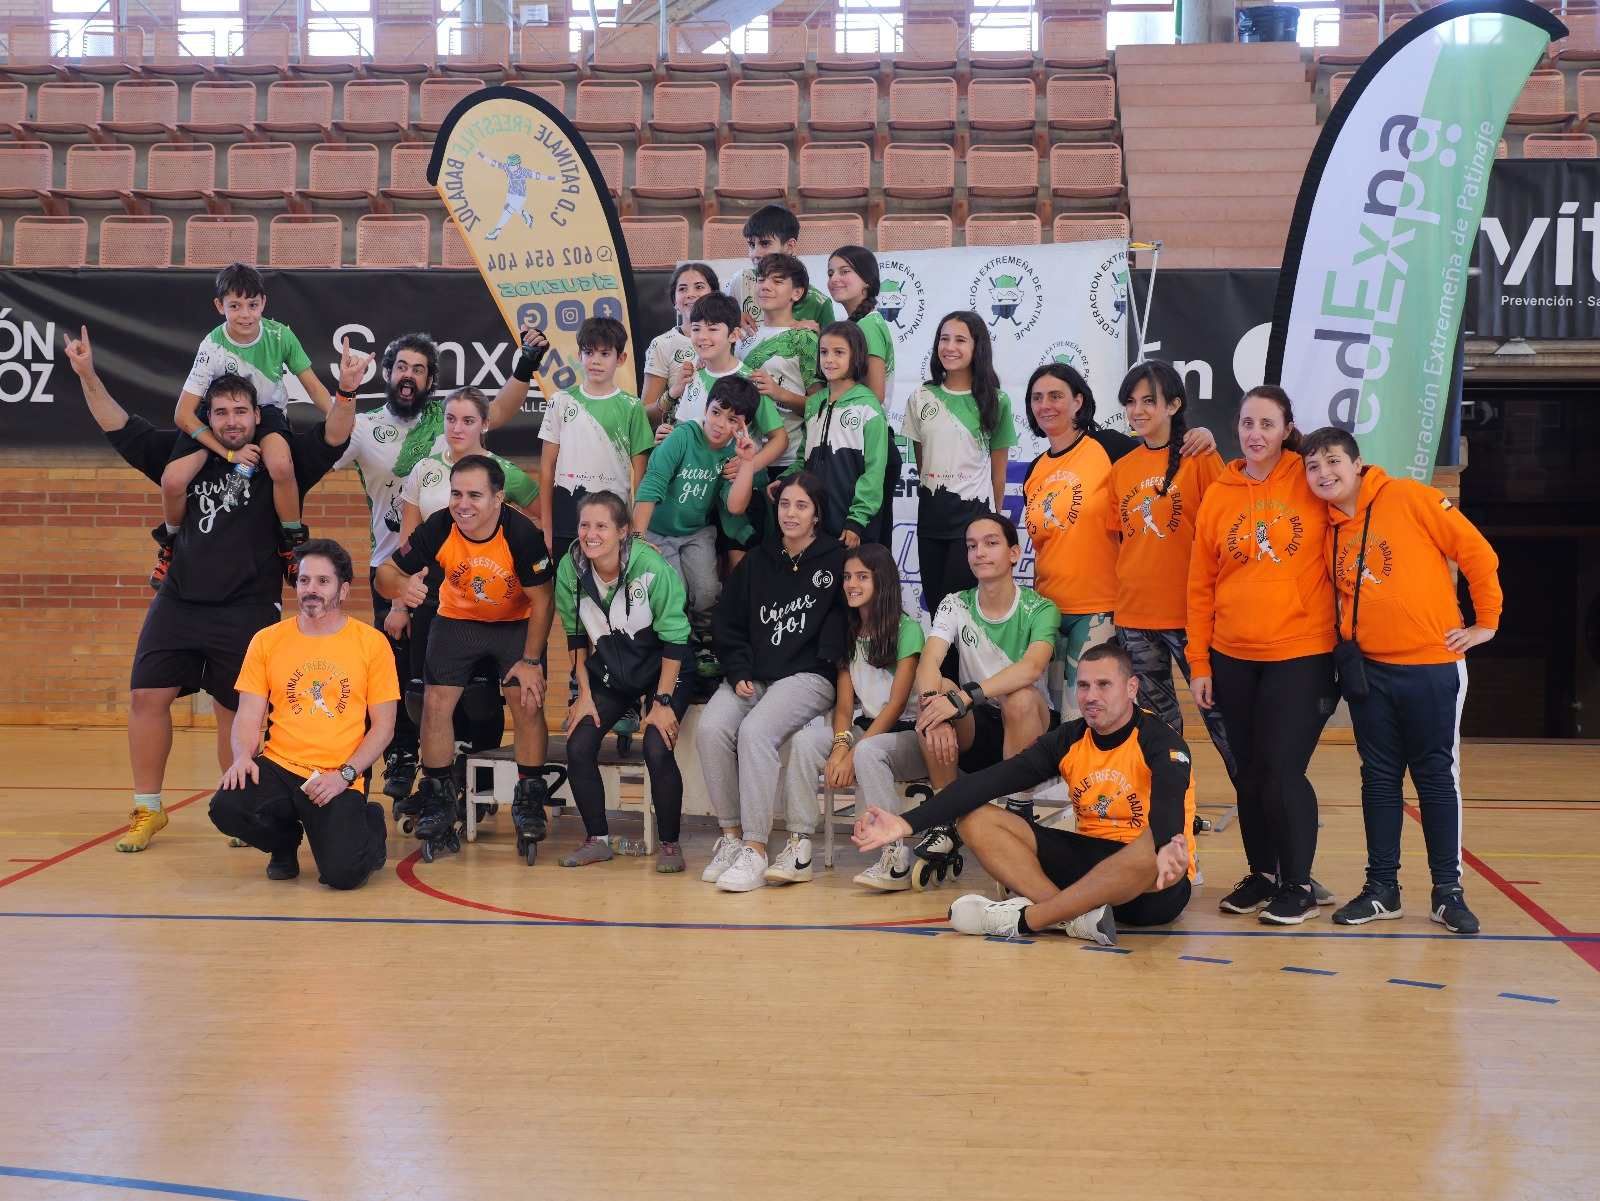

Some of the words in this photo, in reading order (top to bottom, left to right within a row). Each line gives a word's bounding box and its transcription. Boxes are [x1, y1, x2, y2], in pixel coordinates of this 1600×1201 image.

[1457, 120, 1495, 211] Patinaje
[1452, 218, 1469, 246] de
[979, 255, 1034, 277] EXTREMEÑA
[1032, 276, 1042, 293] DE
[914, 280, 924, 296] DE
[1089, 271, 1120, 339] FEDERACIÓN
[1501, 295, 1573, 307] Prevención
[898, 299, 925, 344] PATINAJE
[1014, 295, 1043, 341] PATINAJE
[1424, 253, 1462, 376] Extremeña
[678, 481, 708, 504] go!
[1066, 483, 1083, 525] BADAJOZ
[1170, 492, 1183, 533] BADAJOZ
[1227, 512, 1246, 553] PATINAJE
[1284, 515, 1304, 557] BADAJOZ
[1378, 540, 1393, 577] BADAJOZ
[771, 612, 806, 645] go!
[287, 668, 304, 704] PATINAJE
[335, 677, 350, 714] BADAJOZ
[542, 764, 567, 806] 2
